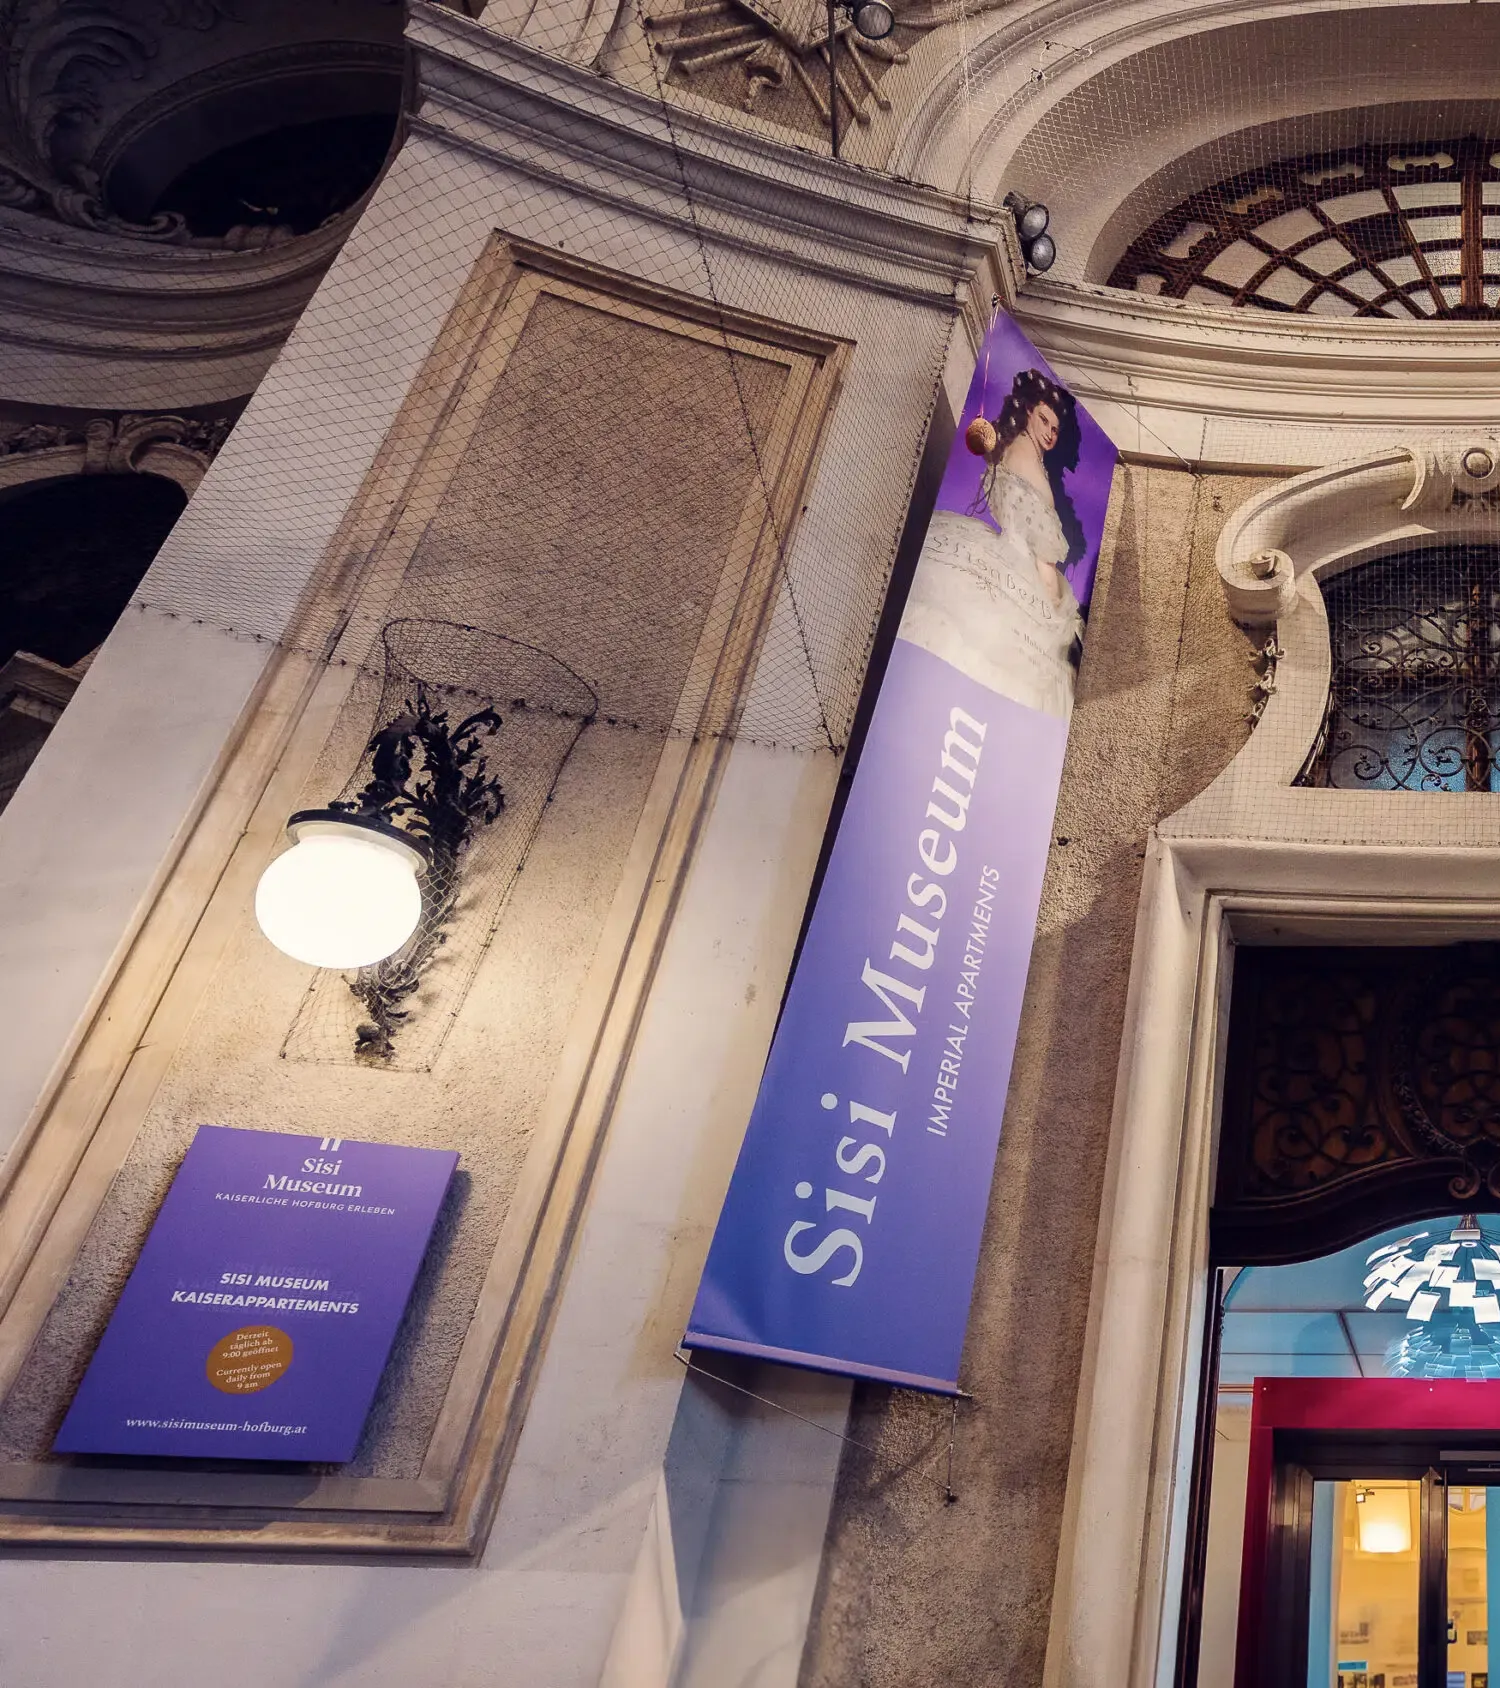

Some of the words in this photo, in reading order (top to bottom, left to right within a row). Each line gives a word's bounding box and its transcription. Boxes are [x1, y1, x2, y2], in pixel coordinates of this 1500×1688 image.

[784, 1092, 897, 1287] Sisi
[842, 706, 988, 1074] Museum
[927, 1025, 969, 1137] IMPERIAL
[959, 864, 1000, 1018] APARTMENTS
[301, 1157, 343, 1176] Sisi
[263, 1174, 363, 1198] Museum
[215, 1192, 289, 1206] KAISERLICHE
[292, 1199, 346, 1212] HOFBURG
[347, 1204, 396, 1216] ERLEBEN
[220, 1272, 253, 1287] SISI
[256, 1274, 330, 1291] MUSEUM
[171, 1291, 360, 1315] KAISERAPPARTEMENTS
[229, 1340, 260, 1351] täglich
[262, 1338, 273, 1346] ab
[236, 1330, 269, 1341] Derzeit
[222, 1350, 241, 1359] 9:00
[242, 1346, 279, 1358] geöffnet
[216, 1363, 258, 1376] Currently
[260, 1362, 282, 1371] open
[225, 1374, 248, 1384] daily
[249, 1371, 271, 1380] from
[244, 1381, 258, 1389] am
[125, 1417, 308, 1436] www.sisimuseum-hofburg.at
